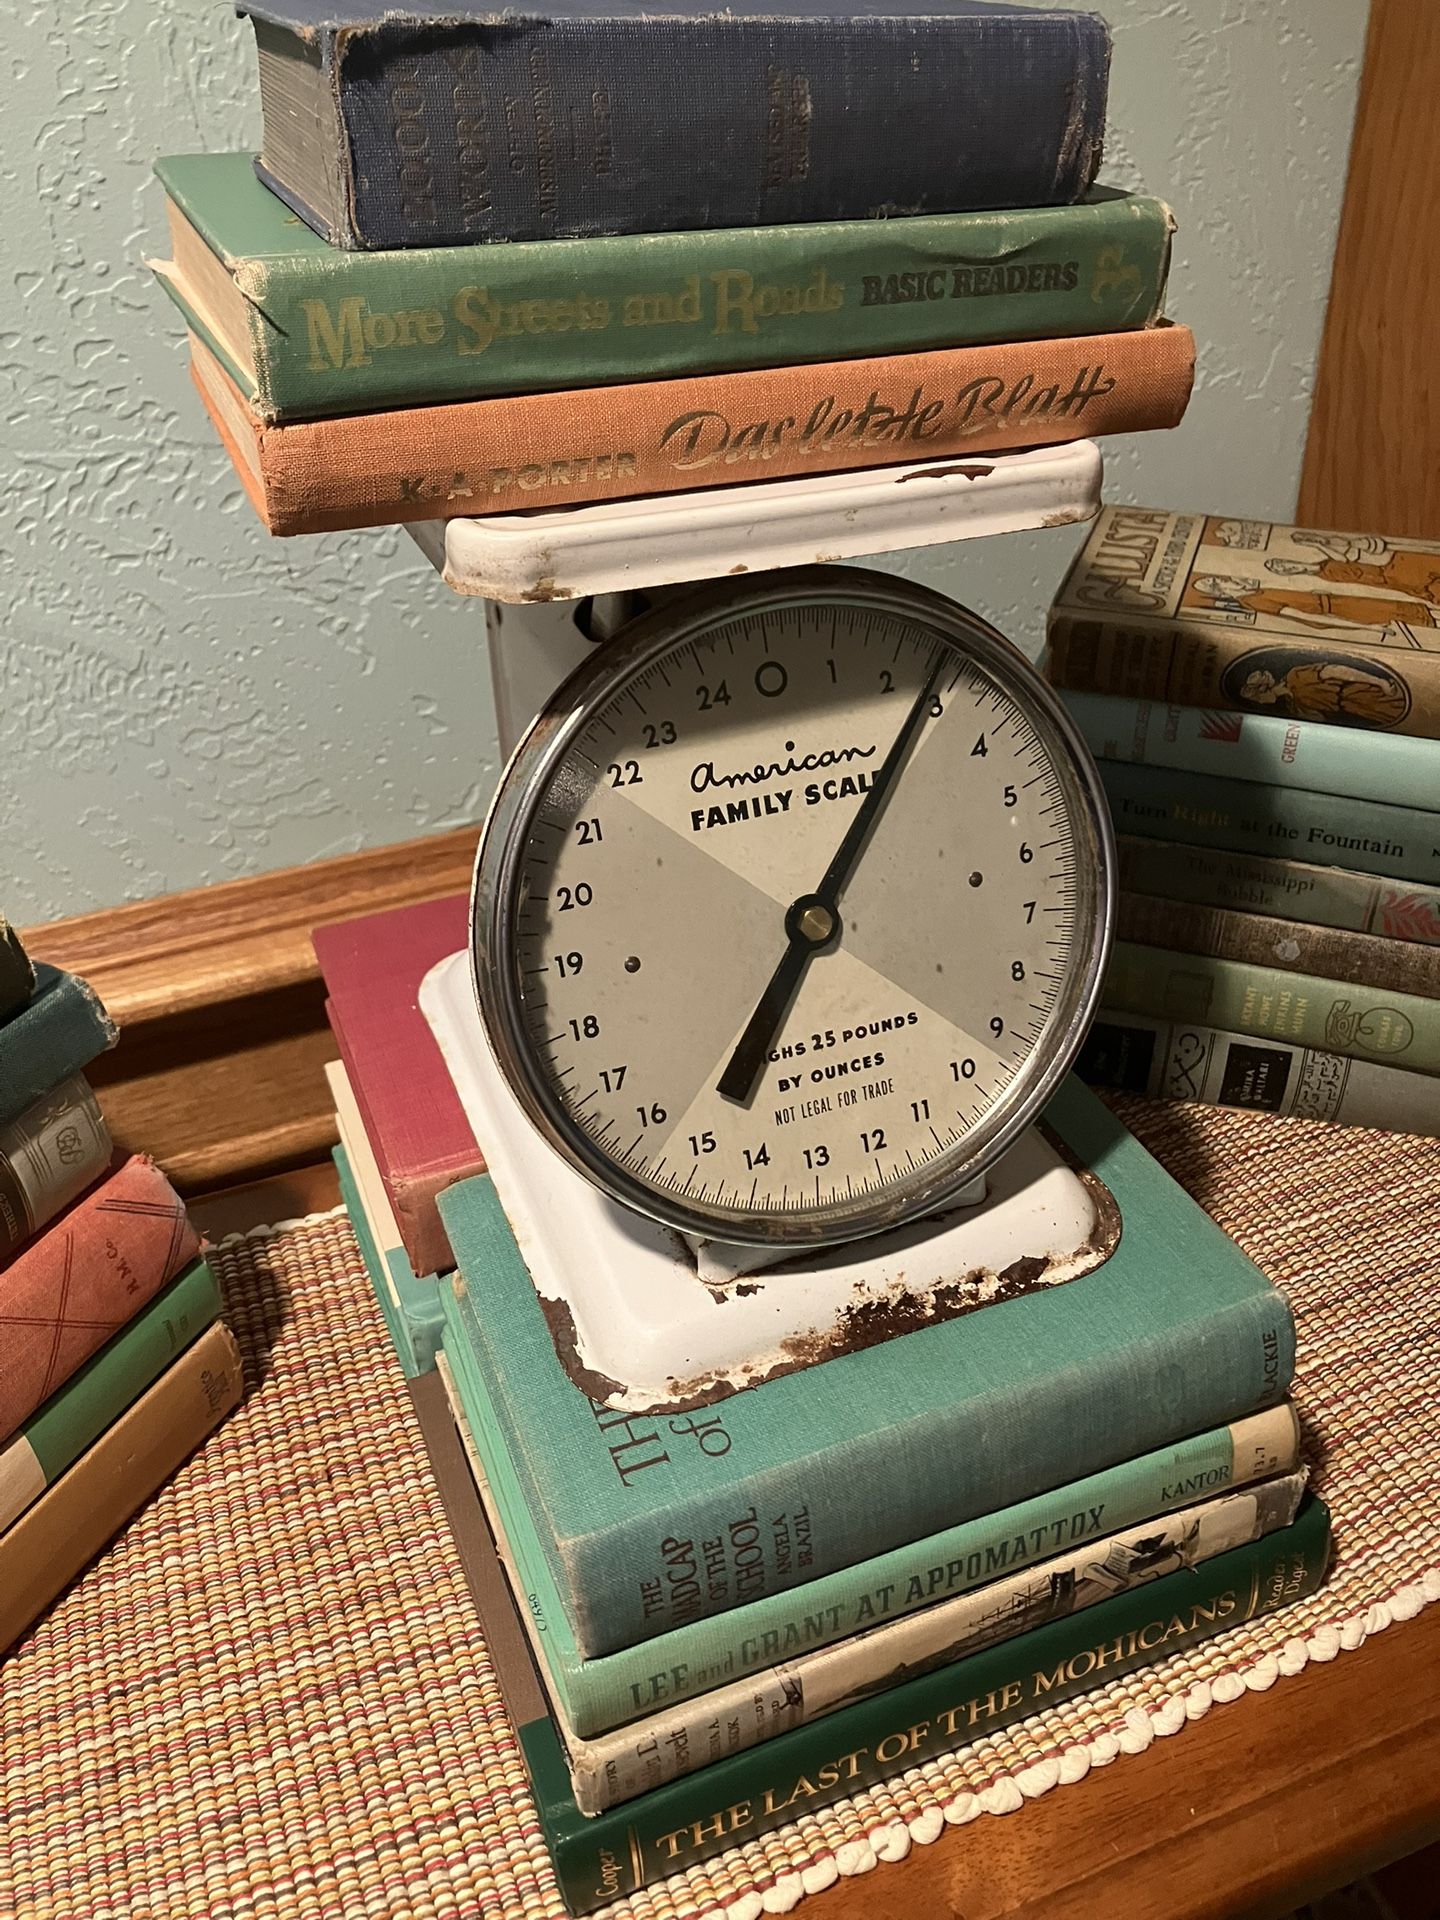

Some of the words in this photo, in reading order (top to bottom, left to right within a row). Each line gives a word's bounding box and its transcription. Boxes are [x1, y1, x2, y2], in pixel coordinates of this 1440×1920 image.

[302, 297, 444, 373] More
[455, 286, 608, 356] Streets
[623, 276, 700, 327] and
[711, 262, 846, 336] Roads
[860, 269, 948, 307] BASIC
[950, 261, 1080, 299] READERS
[826, 659, 838, 684] 1
[879, 670, 896, 695] 2
[696, 680, 732, 711] 24
[928, 694, 944, 719] 3
[642, 720, 678, 749] 23
[970, 732, 988, 758] 4
[606, 760, 643, 788] 22
[690, 789, 793, 832] FAMILY
[1003, 784, 1018, 808] 5
[575, 817, 604, 846] 21
[1121, 798, 1168, 820] Turn
[1268, 821, 1300, 841] the
[1307, 827, 1405, 858] Fountain
[1019, 842, 1034, 864] 6
[556, 881, 593, 912] 20
[1022, 901, 1037, 925] 7
[554, 951, 584, 979] 19
[1011, 961, 1026, 982] 8
[568, 1014, 600, 1042] 18
[811, 1030, 836, 1052] 25
[842, 1012, 919, 1043] POUNDS
[989, 1016, 1004, 1039] 9
[599, 1065, 628, 1093] 17
[778, 1075, 802, 1093] BY
[810, 1052, 885, 1083] OUNCES
[949, 1058, 976, 1082] 10
[636, 1102, 668, 1128] 16
[774, 1105, 795, 1127] NOT
[800, 1096, 833, 1119] LEGAL
[837, 1088, 858, 1109] FOR
[861, 1078, 895, 1101] TRADE
[910, 1099, 931, 1123] 11
[688, 1131, 717, 1157] 15
[860, 1128, 888, 1153] 12
[742, 1142, 771, 1171] 14
[802, 1145, 830, 1170] 13
[1261, 1329, 1278, 1395] LACKIE
[669, 1415, 732, 1458] of
[772, 1512, 792, 1575] ANGELA
[793, 1505, 814, 1568] BRAZIL
[703, 1535, 727, 1577] THE
[728, 1506, 766, 1597] SCHOOL
[630, 1664, 690, 1709] LEE
[697, 1653, 735, 1684] and
[742, 1605, 845, 1660] GRANT
[855, 1584, 896, 1623] AT
[904, 1503, 1107, 1601] APPOMATTOX
[1160, 1464, 1231, 1503] KANTOR
[661, 1536, 700, 1625] MADCAP
[709, 1577, 729, 1601] OF
[640, 1576, 665, 1620] THE
[595, 1847, 623, 1897] Cooper
[656, 1801, 755, 1860] THE
[762, 1748, 869, 1816] LAST
[875, 1720, 931, 1763] OF
[935, 1679, 1024, 1737] THE
[1031, 1589, 1238, 1698] MOHICANS
